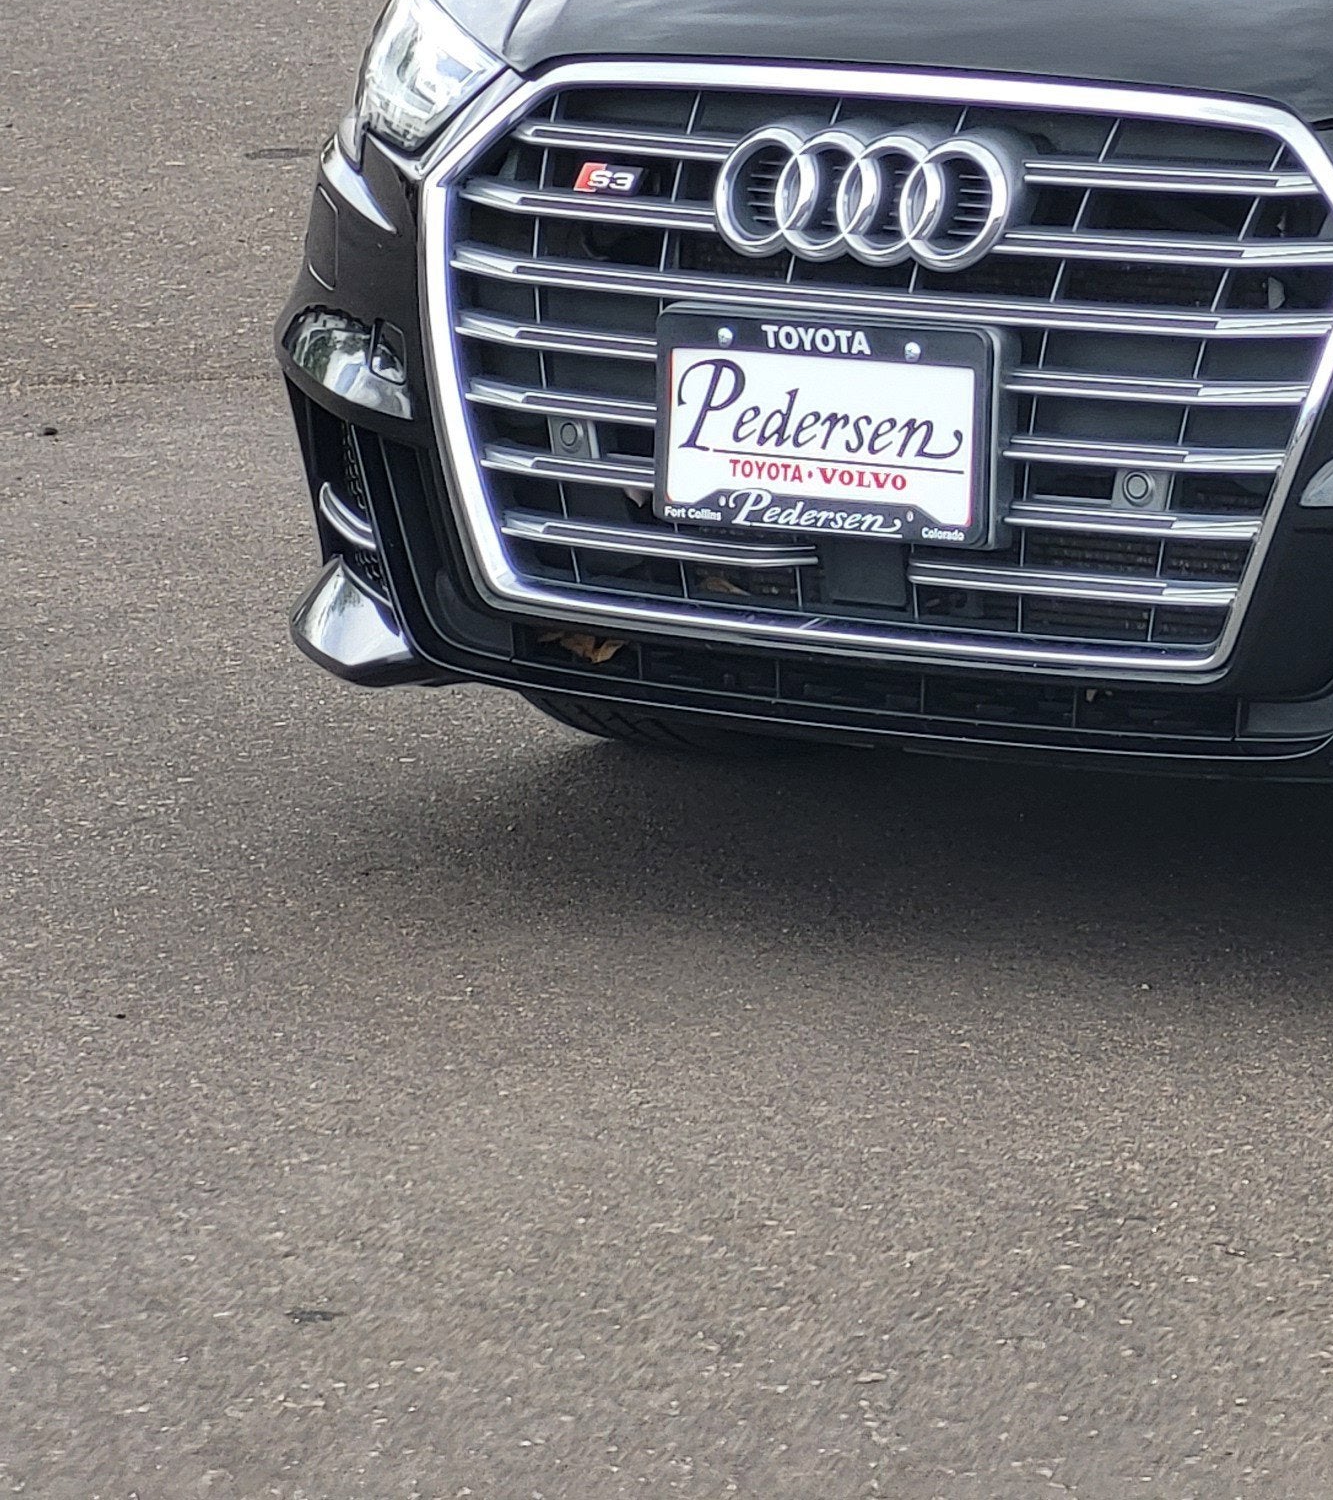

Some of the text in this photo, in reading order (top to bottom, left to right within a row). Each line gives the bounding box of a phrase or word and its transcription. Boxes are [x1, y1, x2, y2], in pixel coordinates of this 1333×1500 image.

[586, 169, 635, 191] S3
[761, 324, 871, 355] TOYOTA
[677, 358, 964, 460] Pedersen
[729, 458, 907, 492] TOYOTA VOLVO
[664, 506, 722, 522] Fort Collins
[727, 487, 902, 534] Pedersen
[921, 526, 966, 542] Colorado
